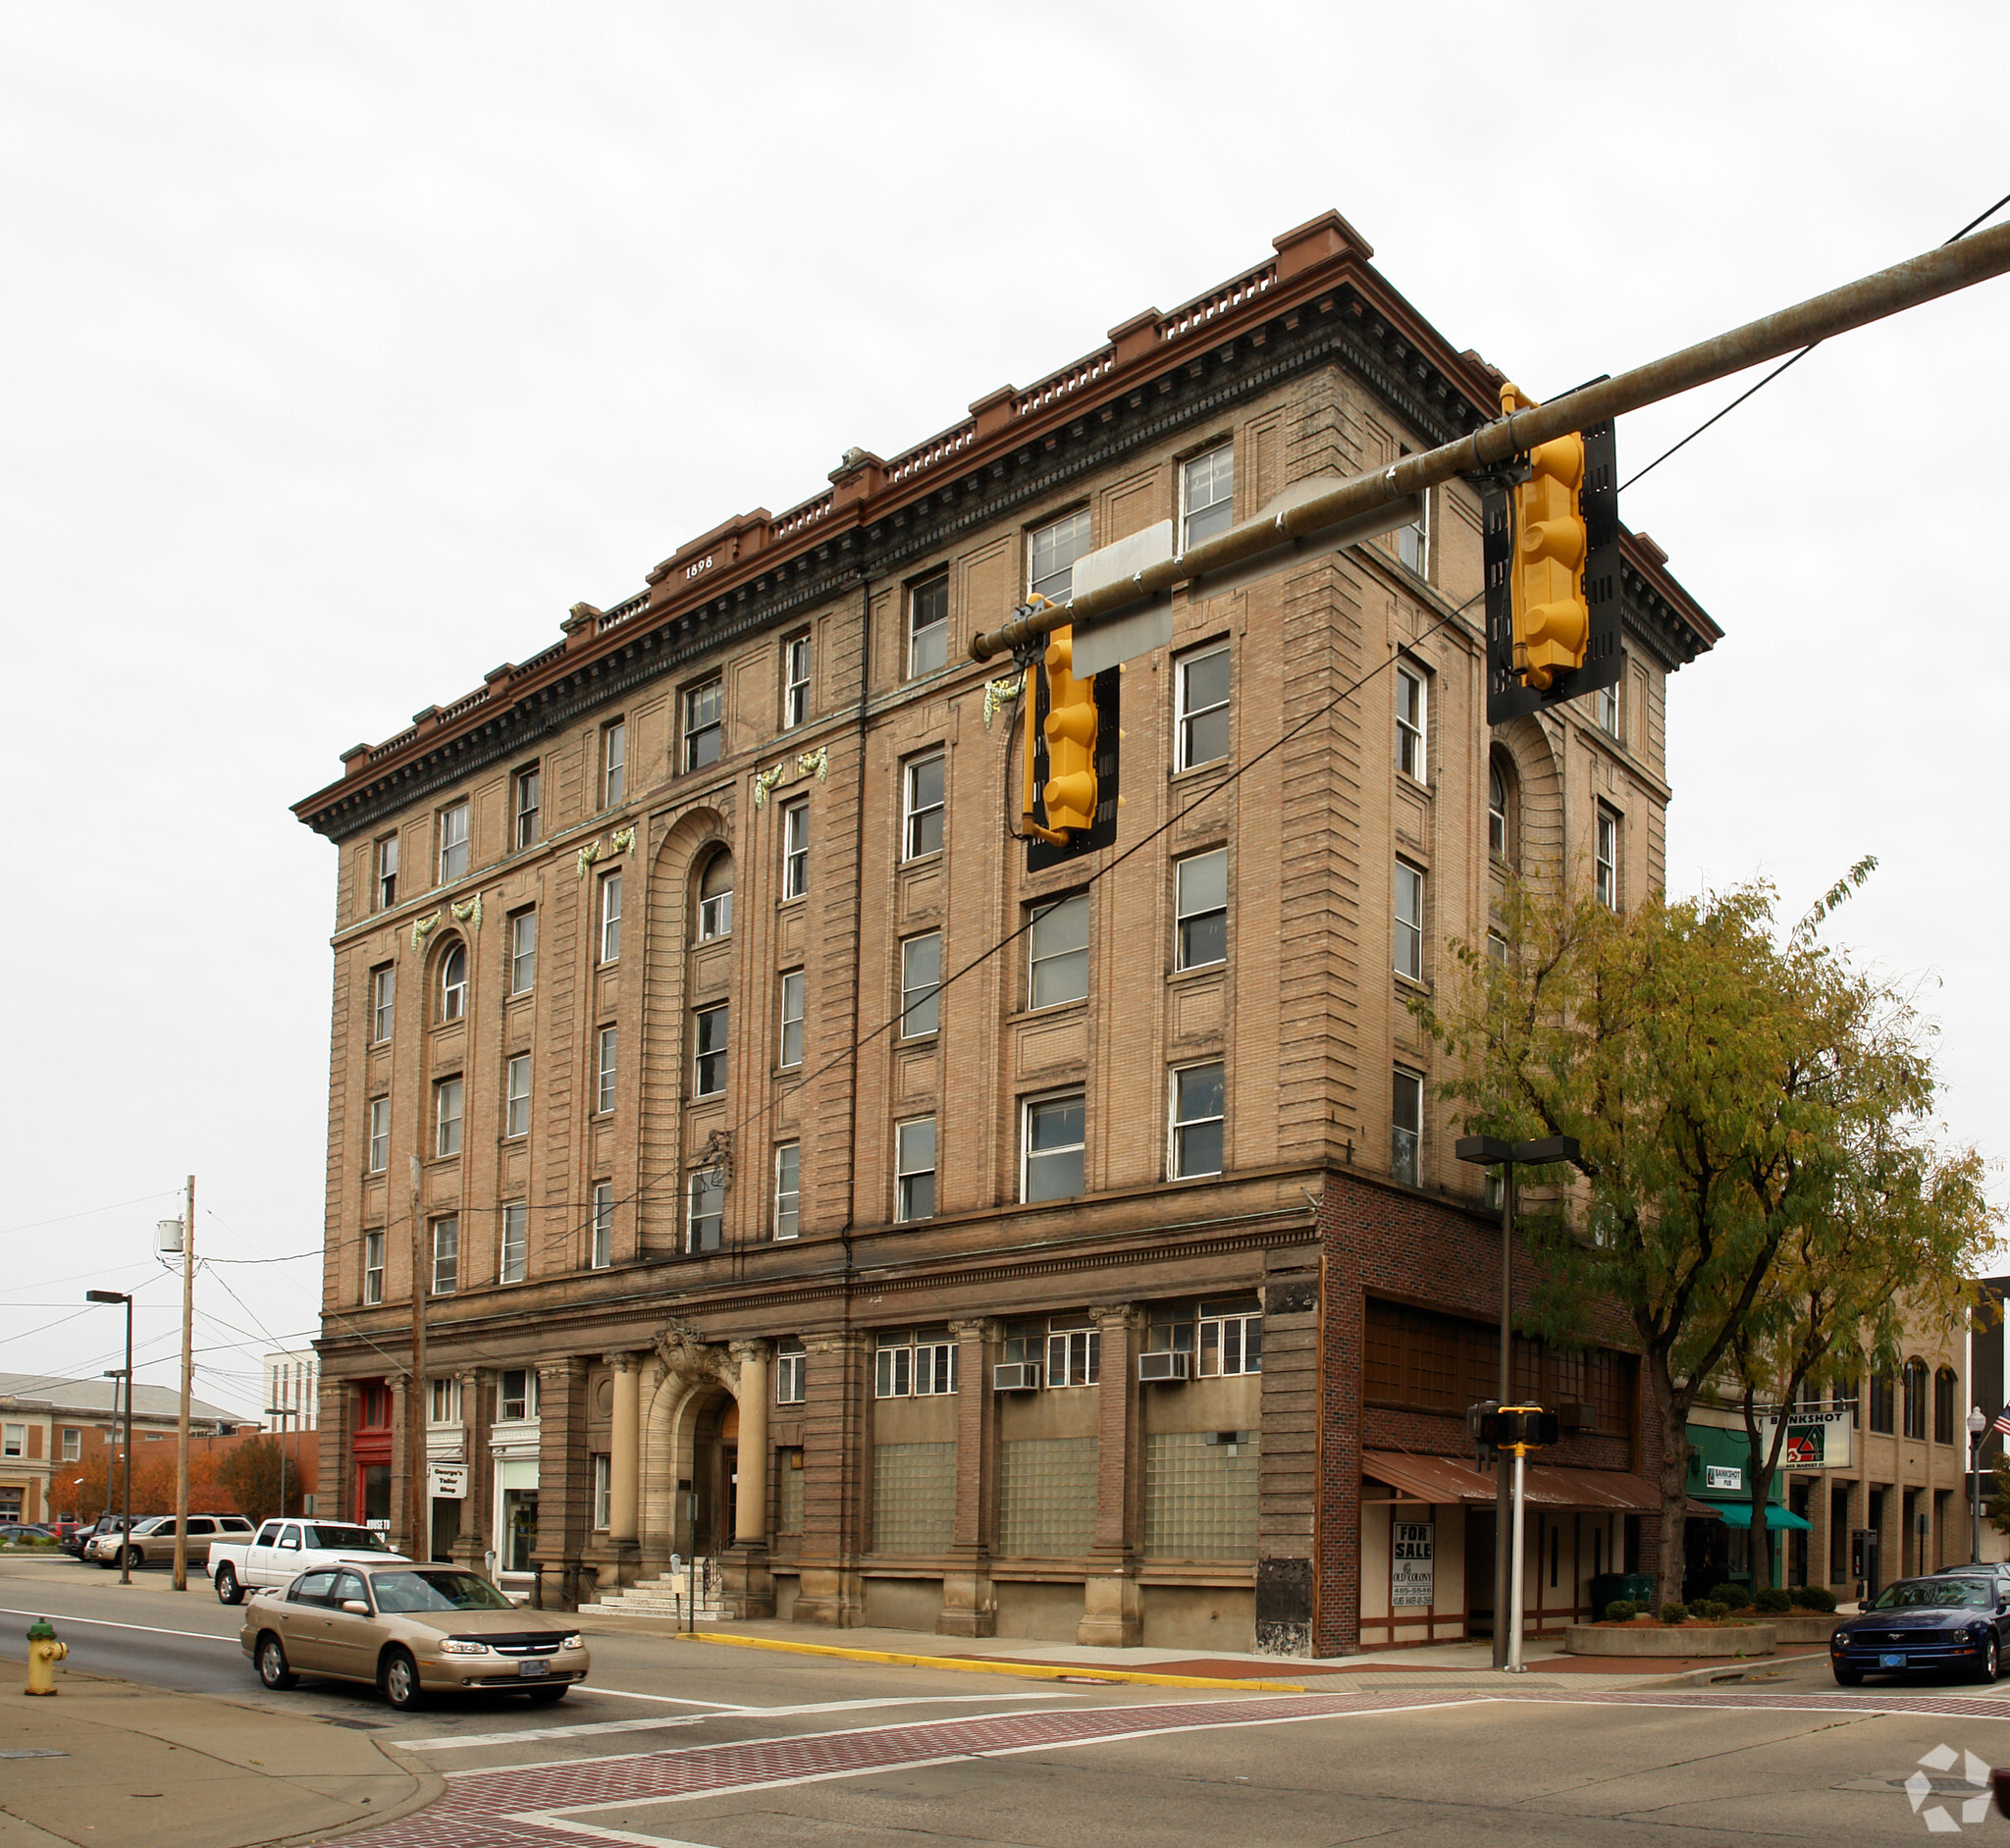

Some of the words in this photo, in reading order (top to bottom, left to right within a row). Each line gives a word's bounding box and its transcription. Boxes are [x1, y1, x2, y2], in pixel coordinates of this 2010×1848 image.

[686, 555, 713, 580] 1898
[1771, 1413, 1842, 1425] BNKSHOT
[1715, 1468, 1740, 1479] BANKSHOT
[1401, 1526, 1427, 1541] FOR
[1396, 1542, 1431, 1558] SALE
[1393, 1572, 1406, 1582] OLD
[1407, 1572, 1432, 1582] COLONY
